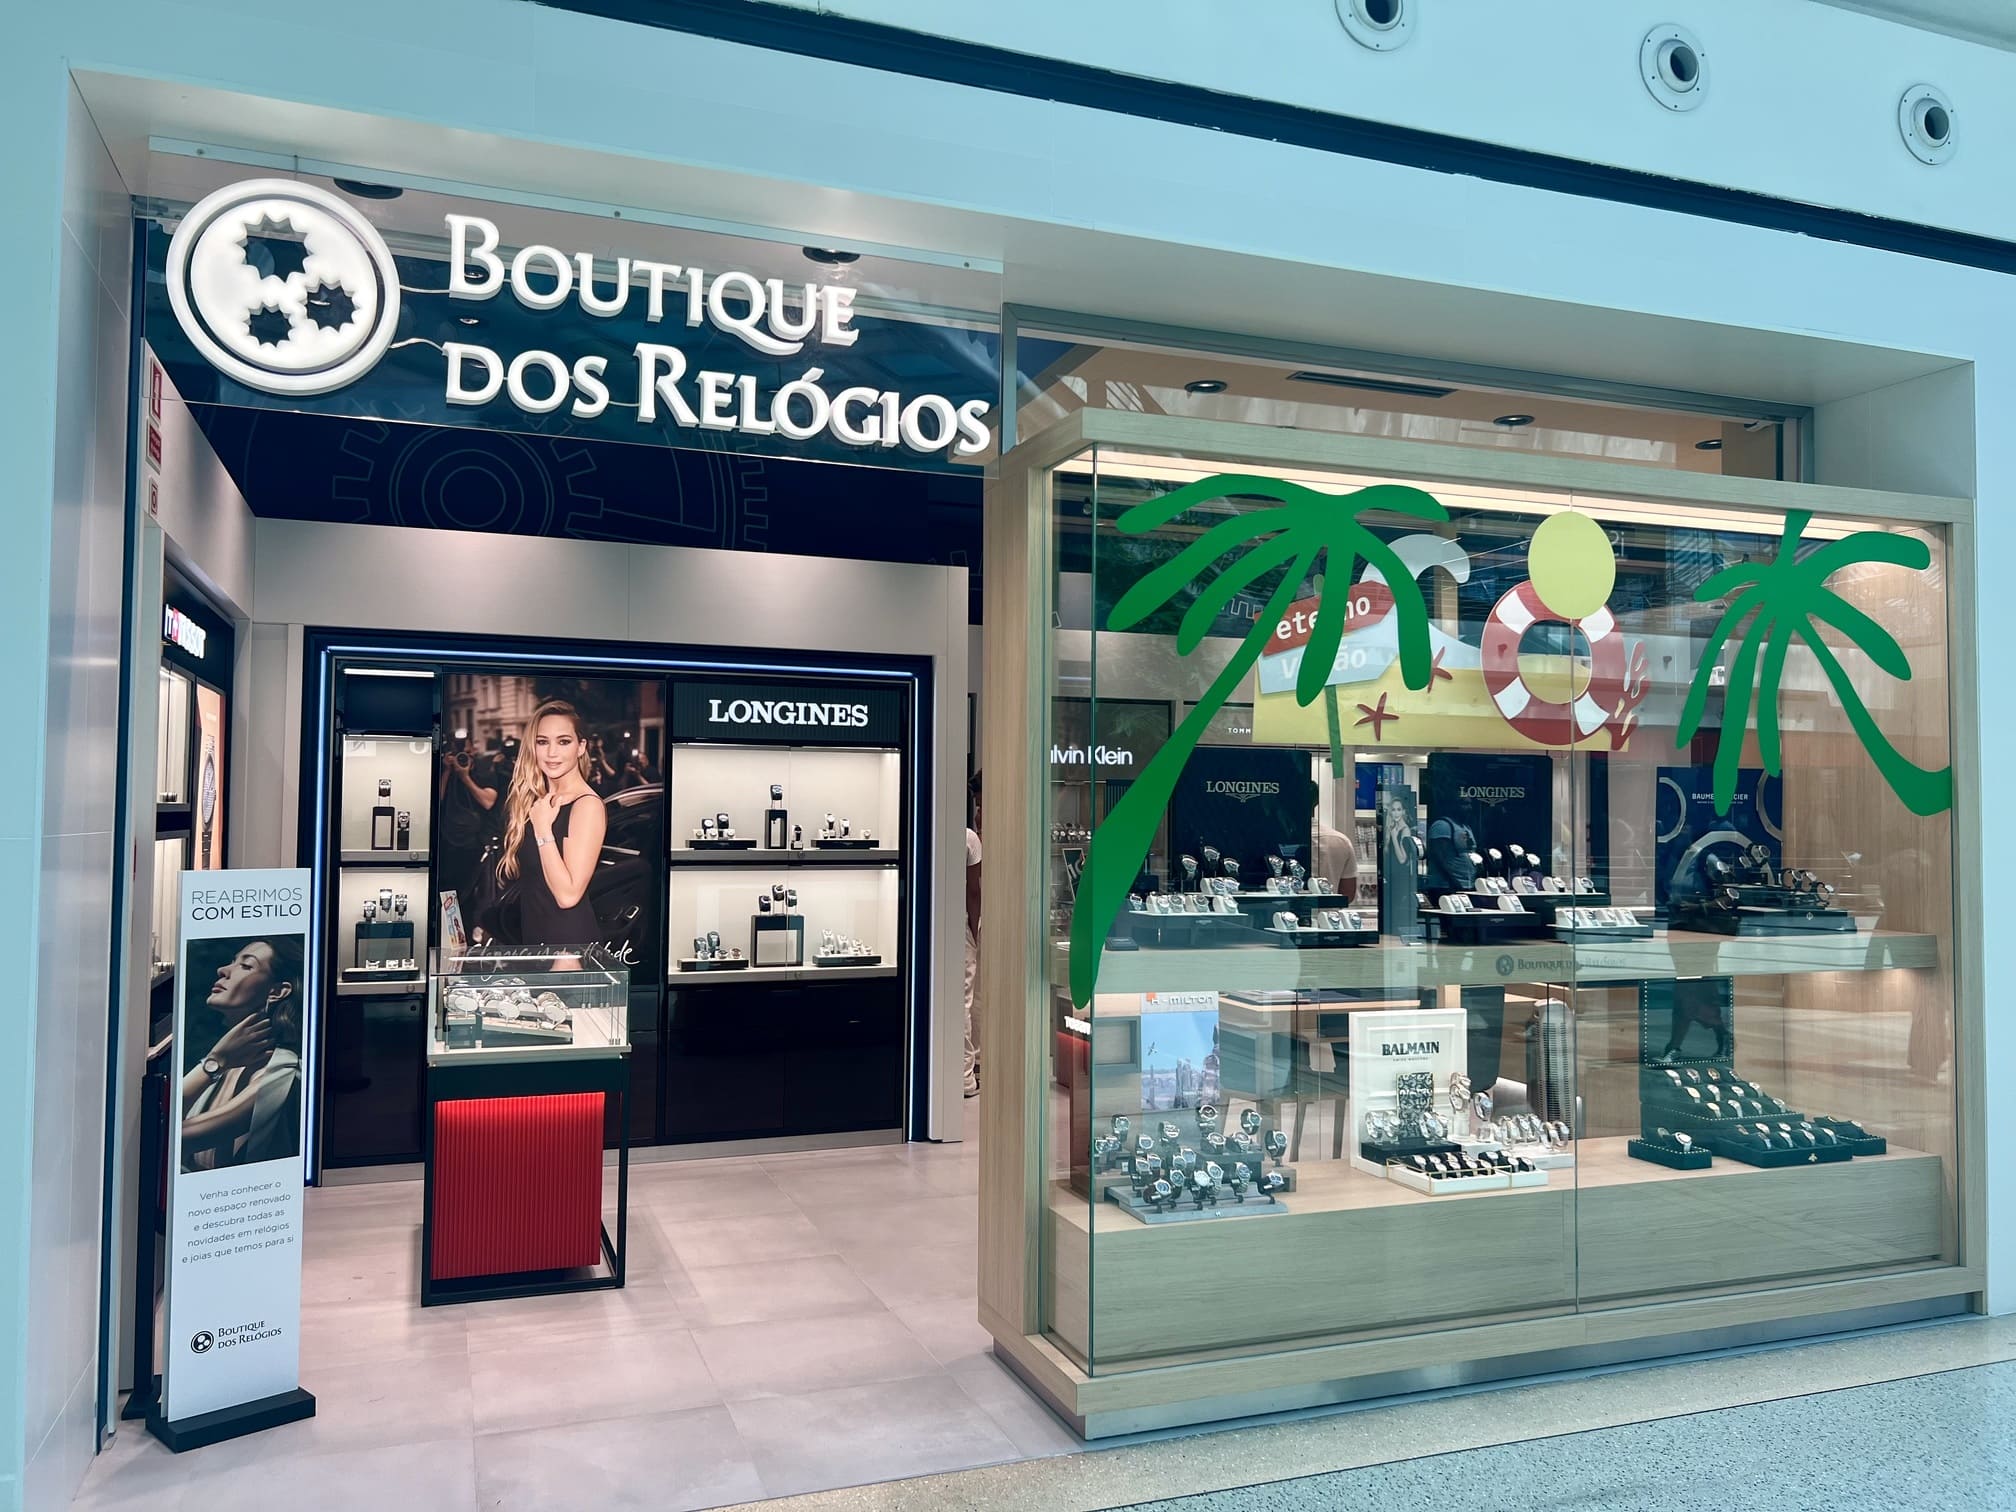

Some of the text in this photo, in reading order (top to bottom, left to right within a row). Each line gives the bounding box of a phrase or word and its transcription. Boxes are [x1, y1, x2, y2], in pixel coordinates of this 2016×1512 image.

[445, 213, 860, 356] BOUTIQUE
[442, 341, 991, 457] DOS RELÓGIOS
[708, 699, 869, 728] LONGINES
[1087, 745, 1133, 765] Klein
[1206, 780, 1280, 794] LONGINES
[1459, 786, 1526, 799] LONGINES
[191, 887, 303, 905] REABRIMOS
[191, 903, 302, 921] COM ESTILO
[1382, 1041, 1440, 1056] BALMAIN
[200, 1190, 228, 1200] Venha
[231, 1183, 273, 1195] conhecer
[188, 1193, 291, 1217] novo espaço renovado
[202, 1217, 245, 1230] descubra
[247, 1212, 273, 1222] todas
[187, 1222, 290, 1247] novidades em relógios
[214, 1248, 232, 1258] que
[234, 1242, 263, 1254] temos
[265, 1238, 285, 1249] para
[218, 1320, 265, 1338] BOUTIQUE
[218, 1327, 282, 1349] DOS RELÓGIOS
